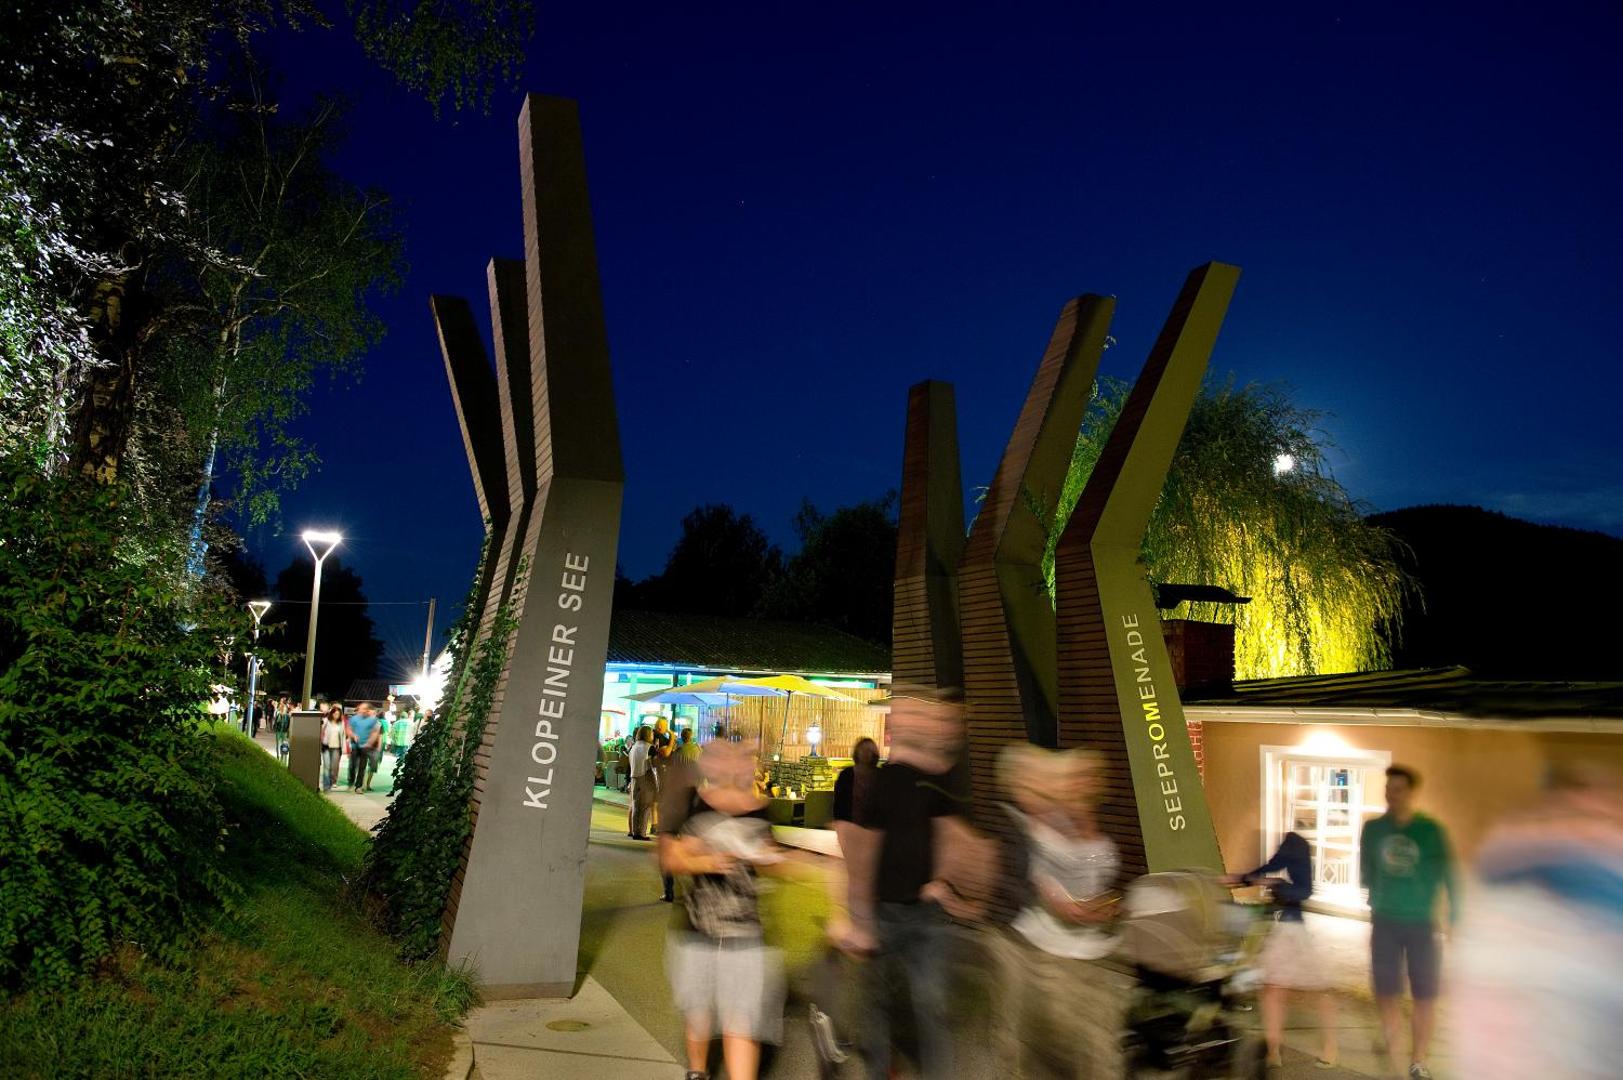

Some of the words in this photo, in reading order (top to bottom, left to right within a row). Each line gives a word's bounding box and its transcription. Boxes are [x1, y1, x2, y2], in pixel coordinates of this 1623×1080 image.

[523, 624, 578, 809] KLOPEINER
[558, 552, 590, 612] SEE
[1122, 613, 1186, 831] SEEPROMENADE
